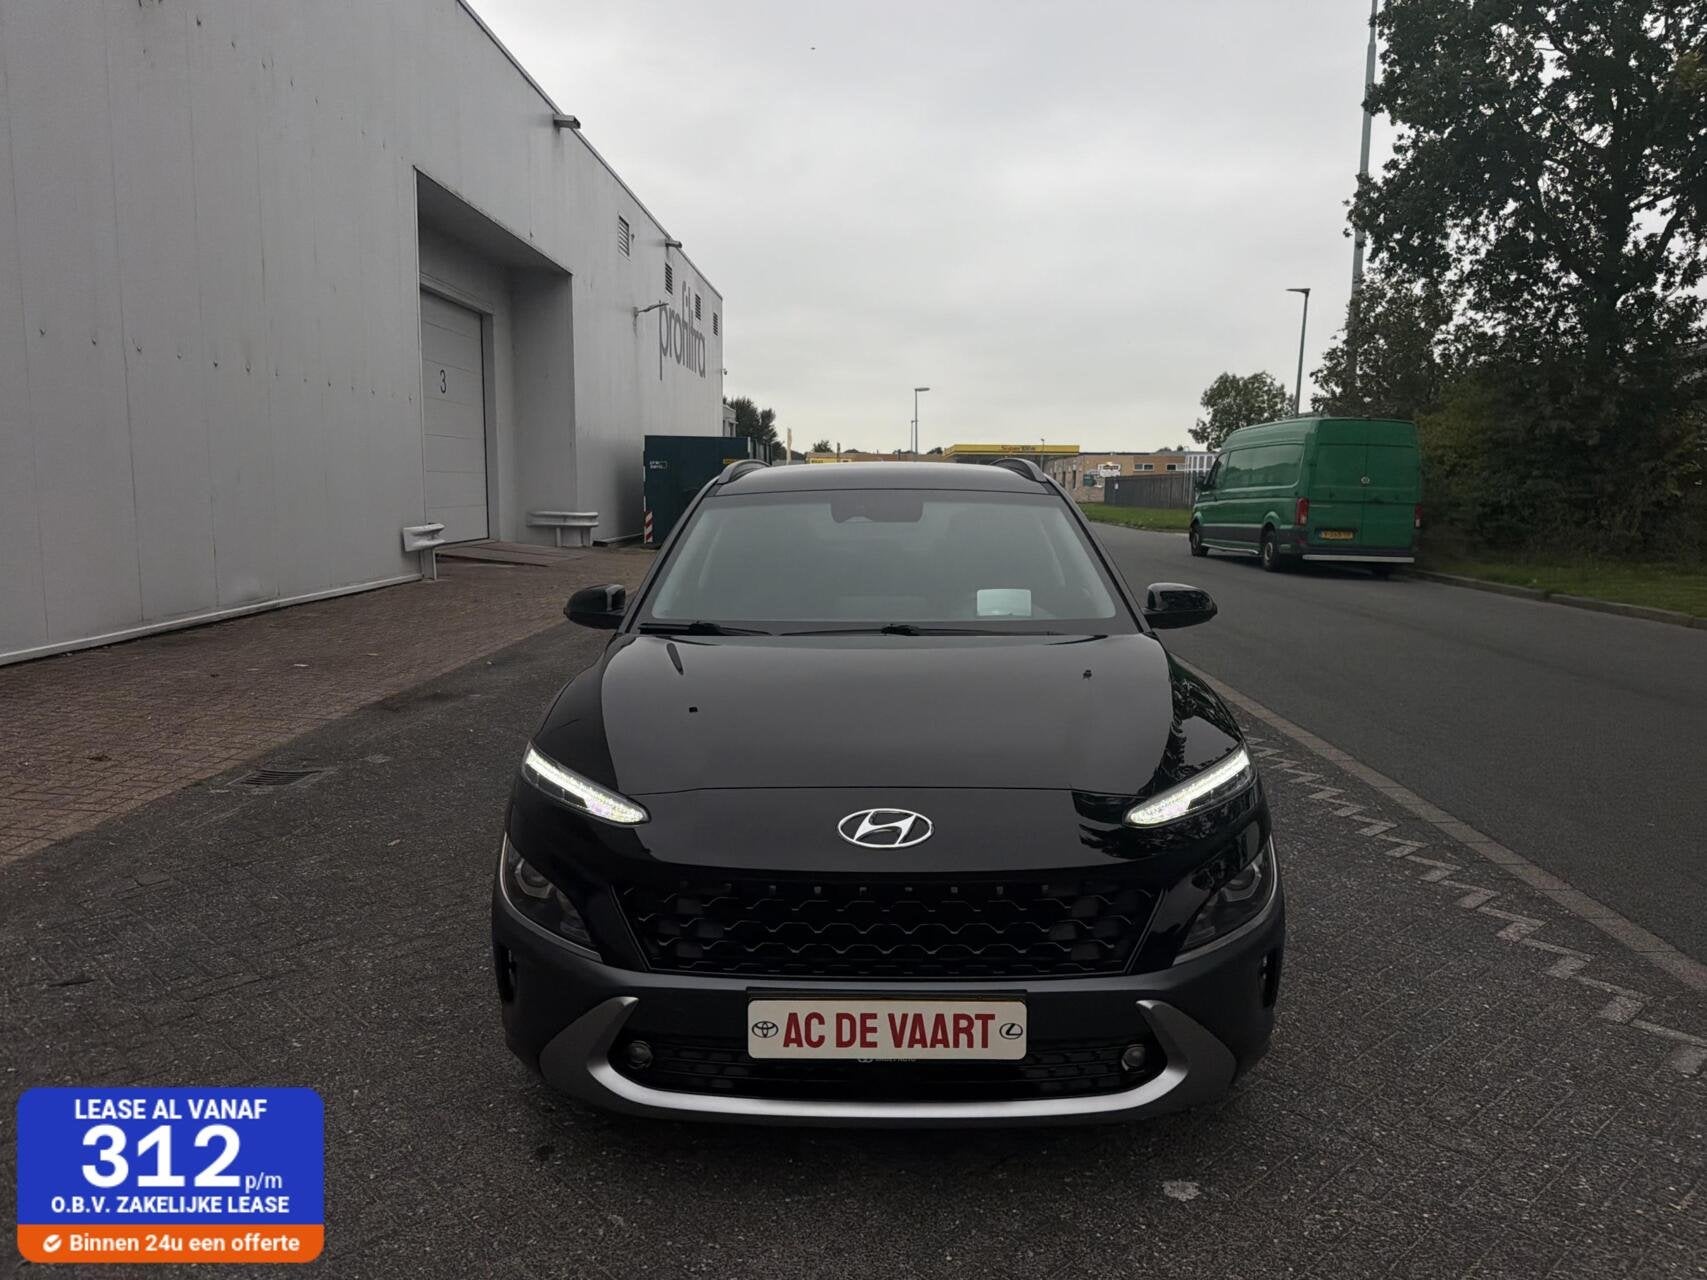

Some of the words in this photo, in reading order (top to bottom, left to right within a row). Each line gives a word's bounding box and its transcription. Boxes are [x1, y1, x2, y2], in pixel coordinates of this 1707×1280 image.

[439, 369, 447, 394] 3
[783, 1012, 826, 1048] AC
[835, 1012, 878, 1048] DE
[888, 1013, 996, 1049] VAART
